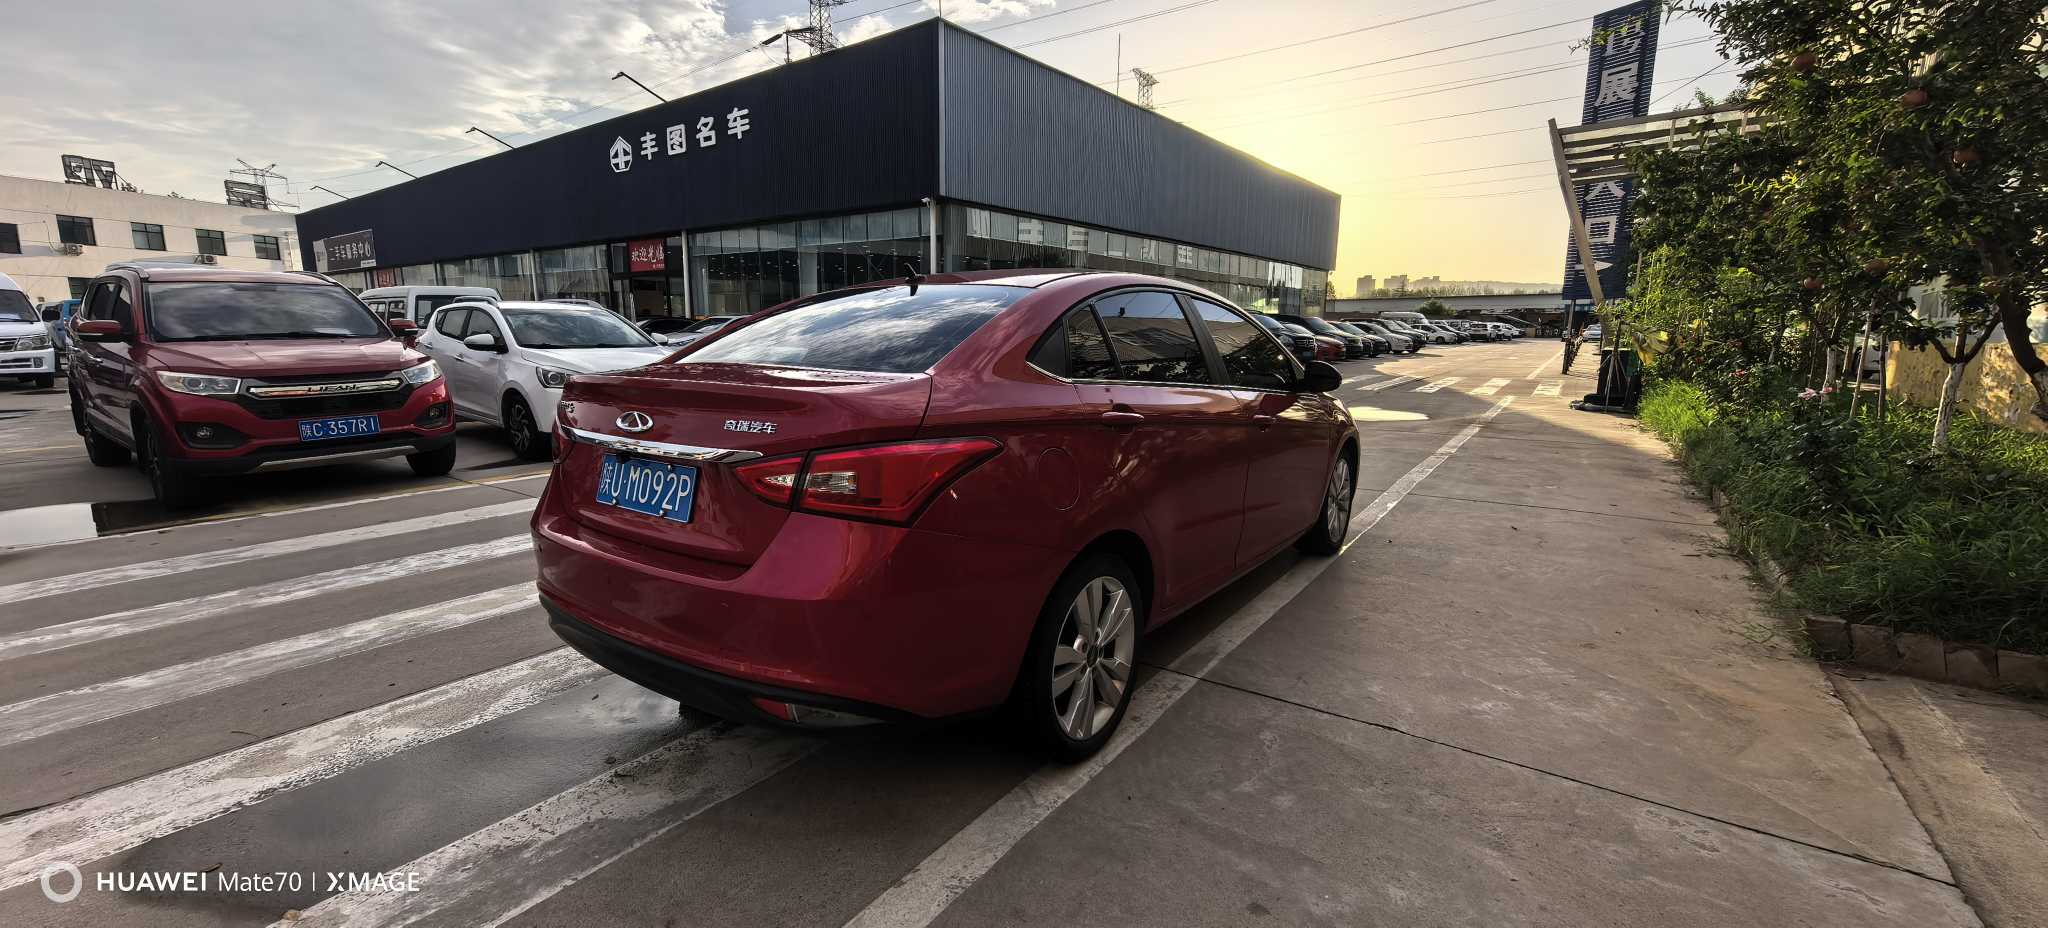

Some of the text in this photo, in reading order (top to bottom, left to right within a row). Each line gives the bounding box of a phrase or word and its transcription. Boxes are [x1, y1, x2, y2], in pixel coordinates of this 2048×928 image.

[640, 107, 750, 160] 丰图名车
[631, 243, 665, 263] 欢迎光临
[723, 419, 778, 434] 奇瑞汽车
